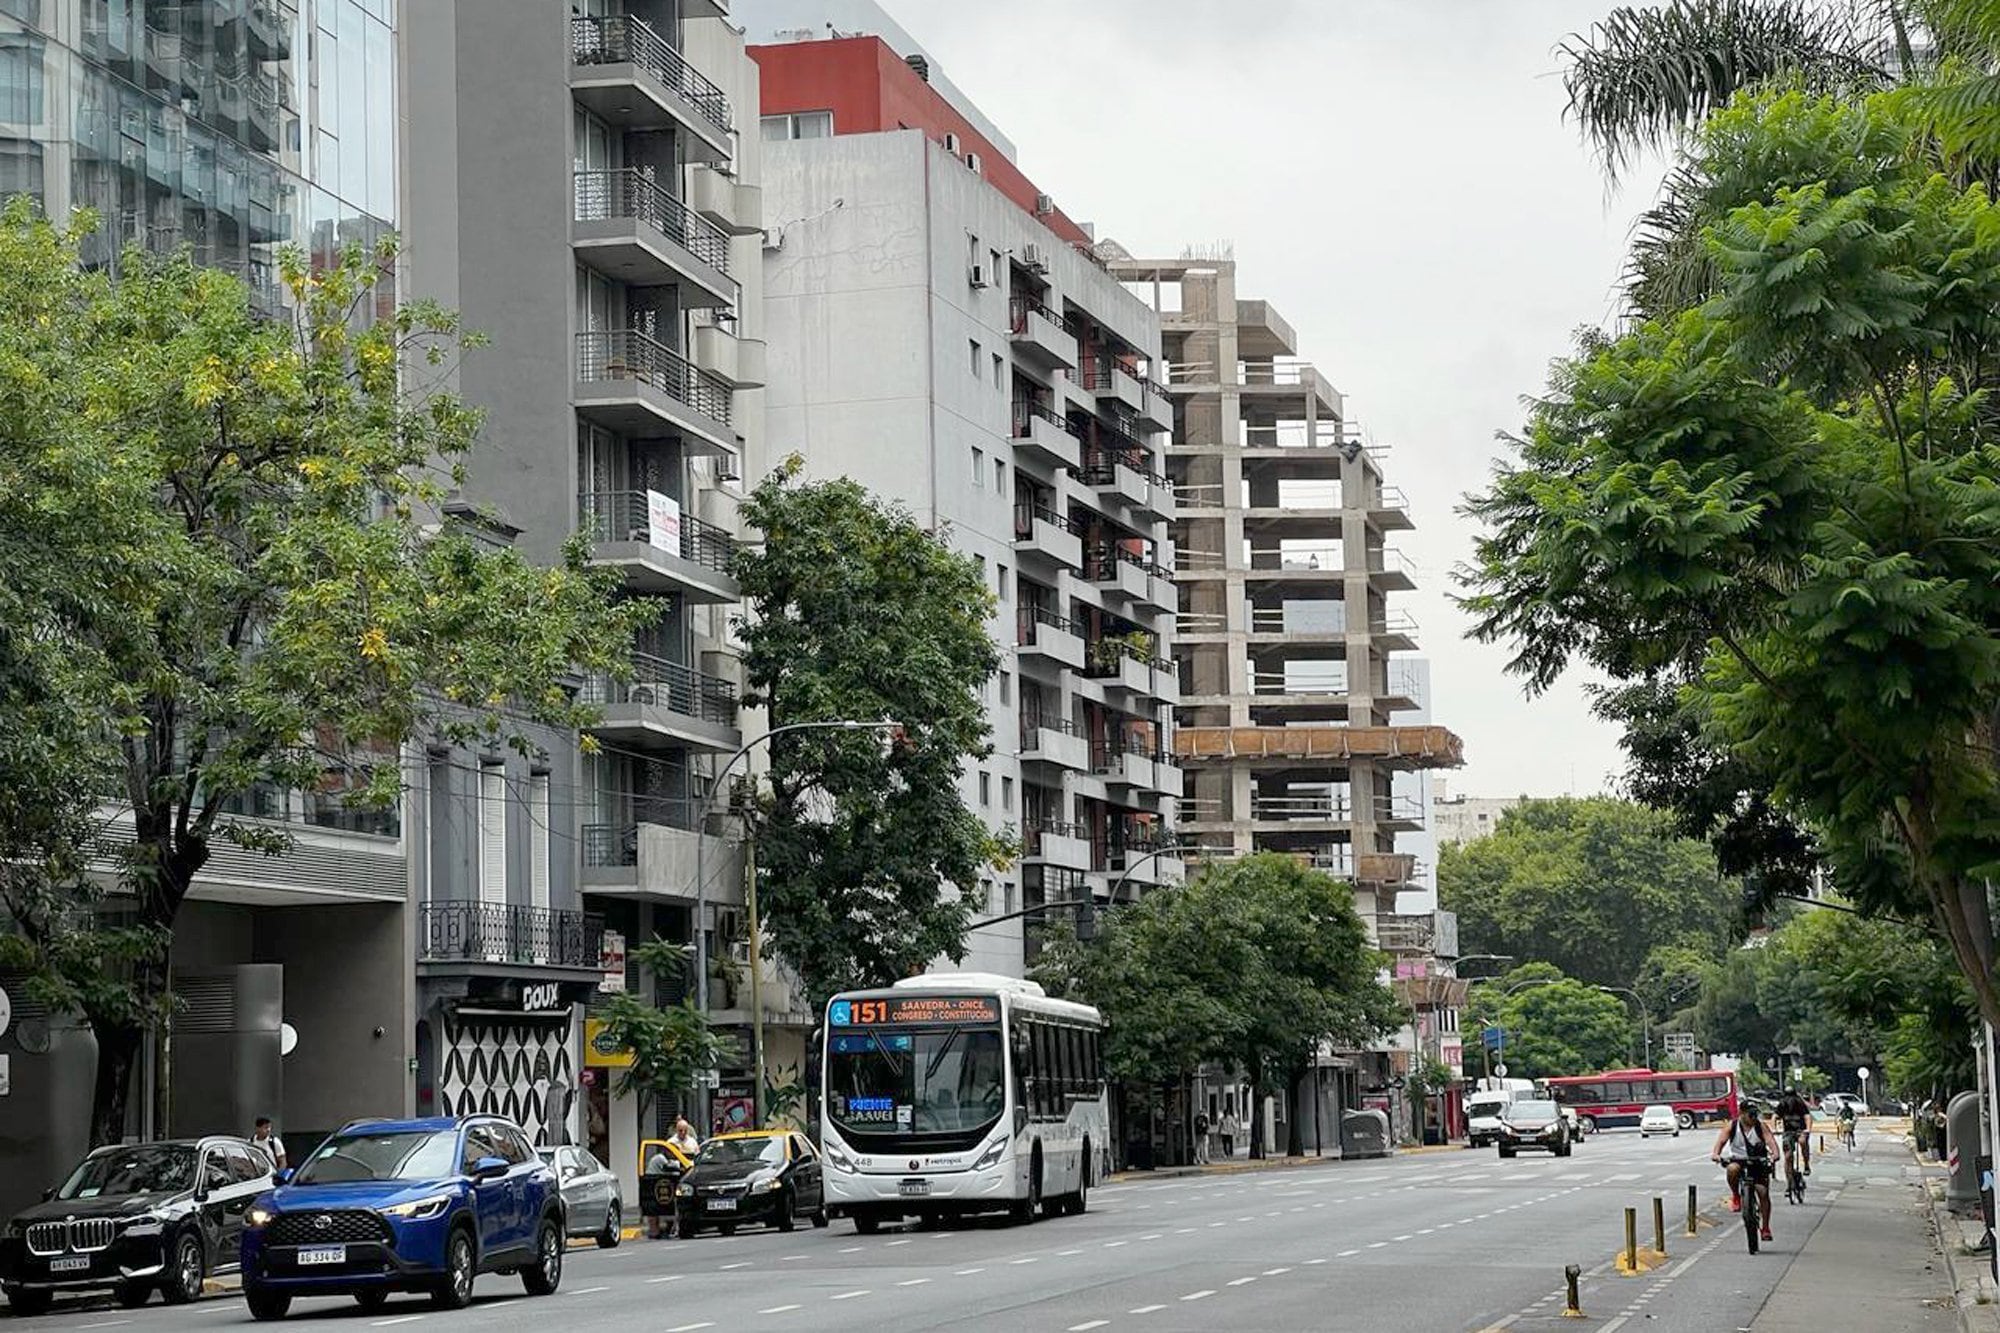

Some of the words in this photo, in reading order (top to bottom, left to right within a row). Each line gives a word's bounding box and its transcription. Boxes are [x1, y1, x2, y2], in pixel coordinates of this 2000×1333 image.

[901, 1001, 950, 1010] SAAVEDRA
[958, 1001, 984, 1009] ONCE
[850, 1001, 887, 1023] 151
[892, 1011, 932, 1020] CONGRESO
[854, 1158, 872, 1166] 448
